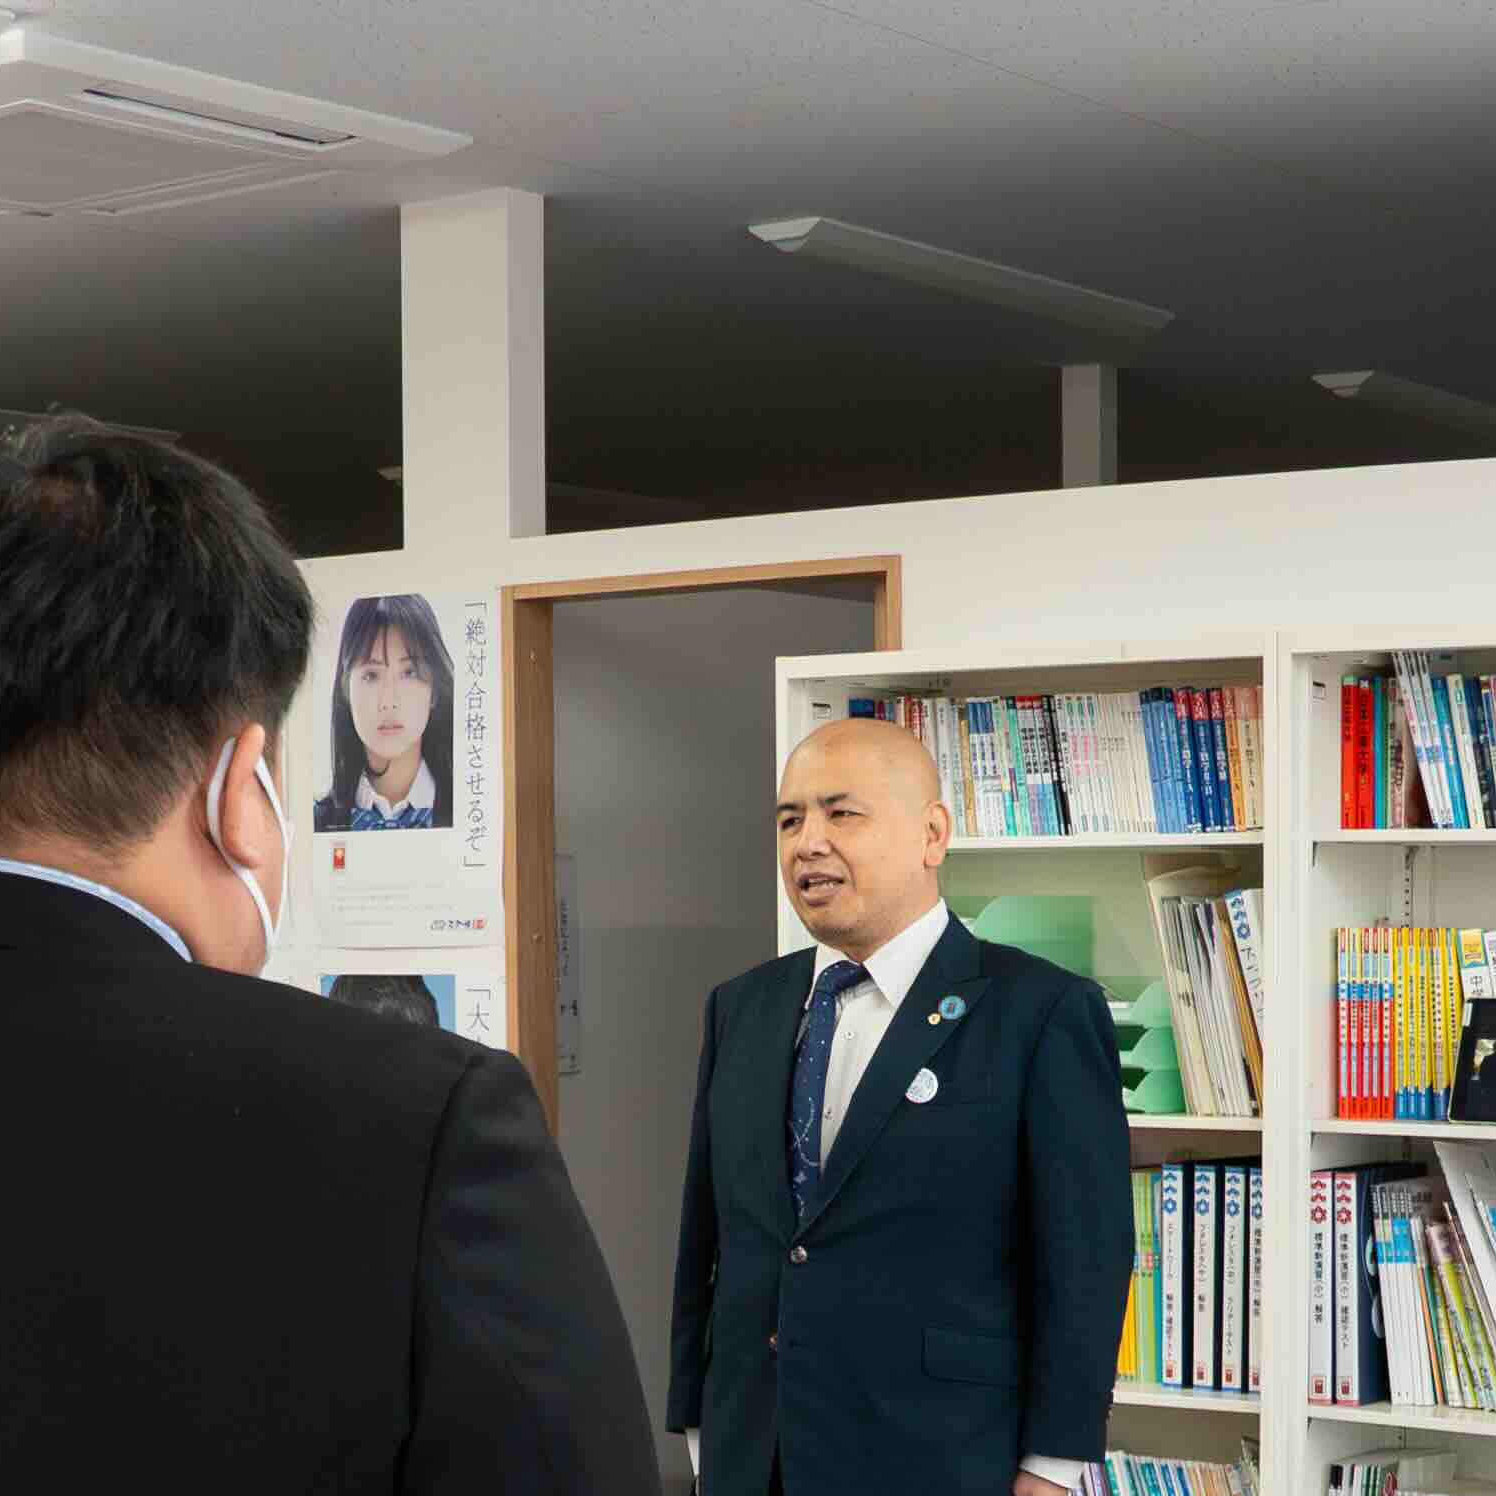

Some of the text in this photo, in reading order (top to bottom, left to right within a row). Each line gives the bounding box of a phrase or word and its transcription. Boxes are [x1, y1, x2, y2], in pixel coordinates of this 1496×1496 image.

[462, 598, 489, 870] 「絶対合格させるぞ」
